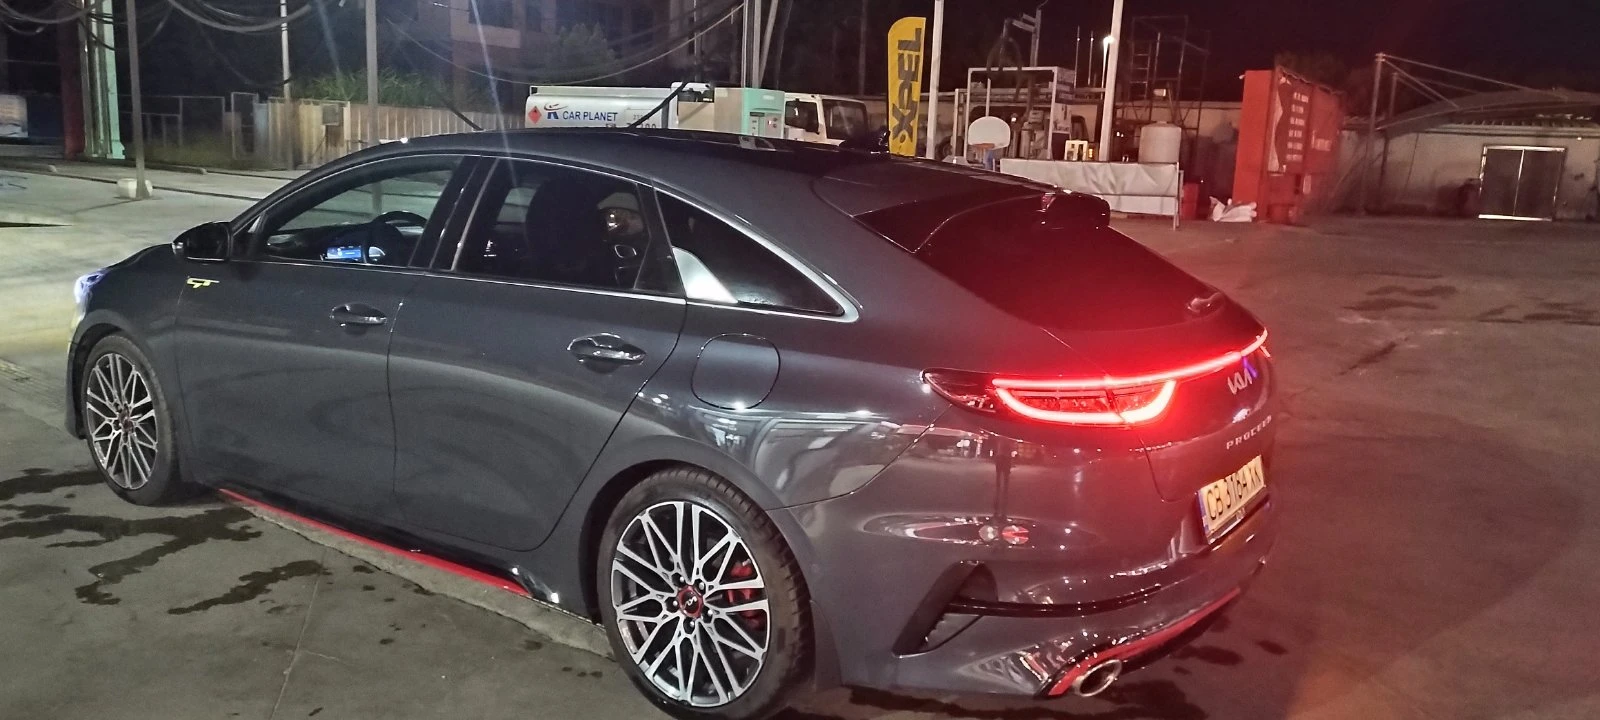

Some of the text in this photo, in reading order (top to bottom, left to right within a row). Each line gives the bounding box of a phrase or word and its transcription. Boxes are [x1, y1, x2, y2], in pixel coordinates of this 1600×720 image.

[562, 110, 618, 122] CAR PLANET
[1226, 415, 1272, 450] PROCEED
[1206, 484, 1224, 520] CB
[1223, 470, 1249, 509] 3164
